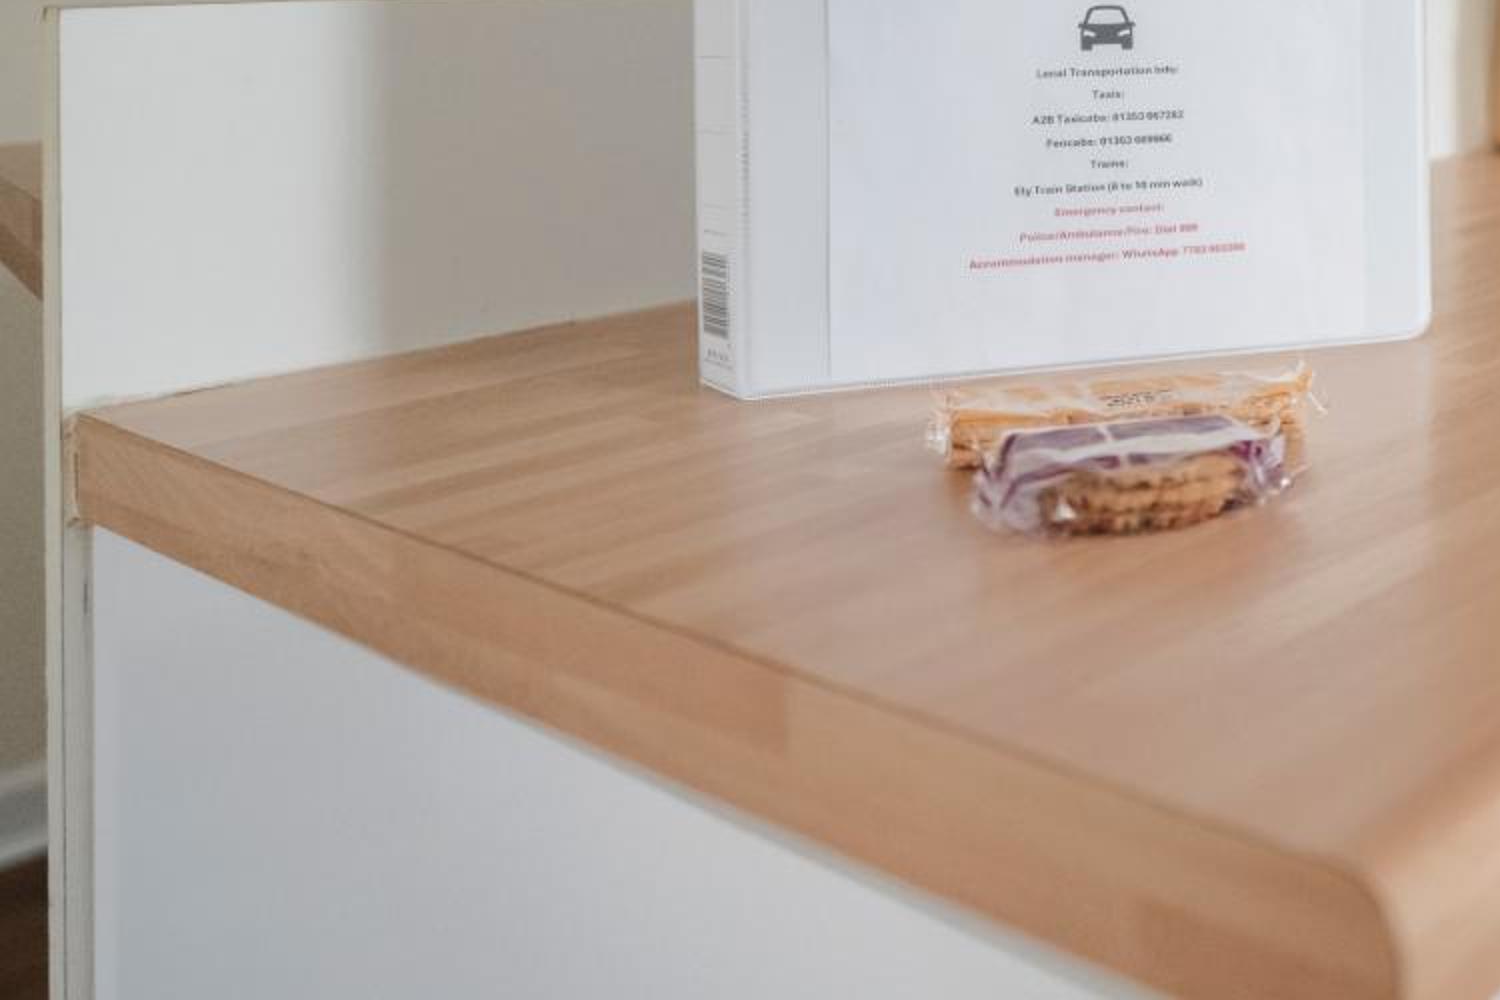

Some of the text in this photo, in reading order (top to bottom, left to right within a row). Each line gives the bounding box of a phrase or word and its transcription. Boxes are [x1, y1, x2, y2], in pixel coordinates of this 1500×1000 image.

[1069, 66, 1152, 79] Transportation
[1092, 89, 1124, 100] Taxis:
[1032, 115, 1055, 125] A2B
[1034, 184, 1063, 195] Train
[1065, 183, 1105, 193] Station
[1120, 182, 1133, 191] to
[1055, 206, 1117, 217] Emergency
